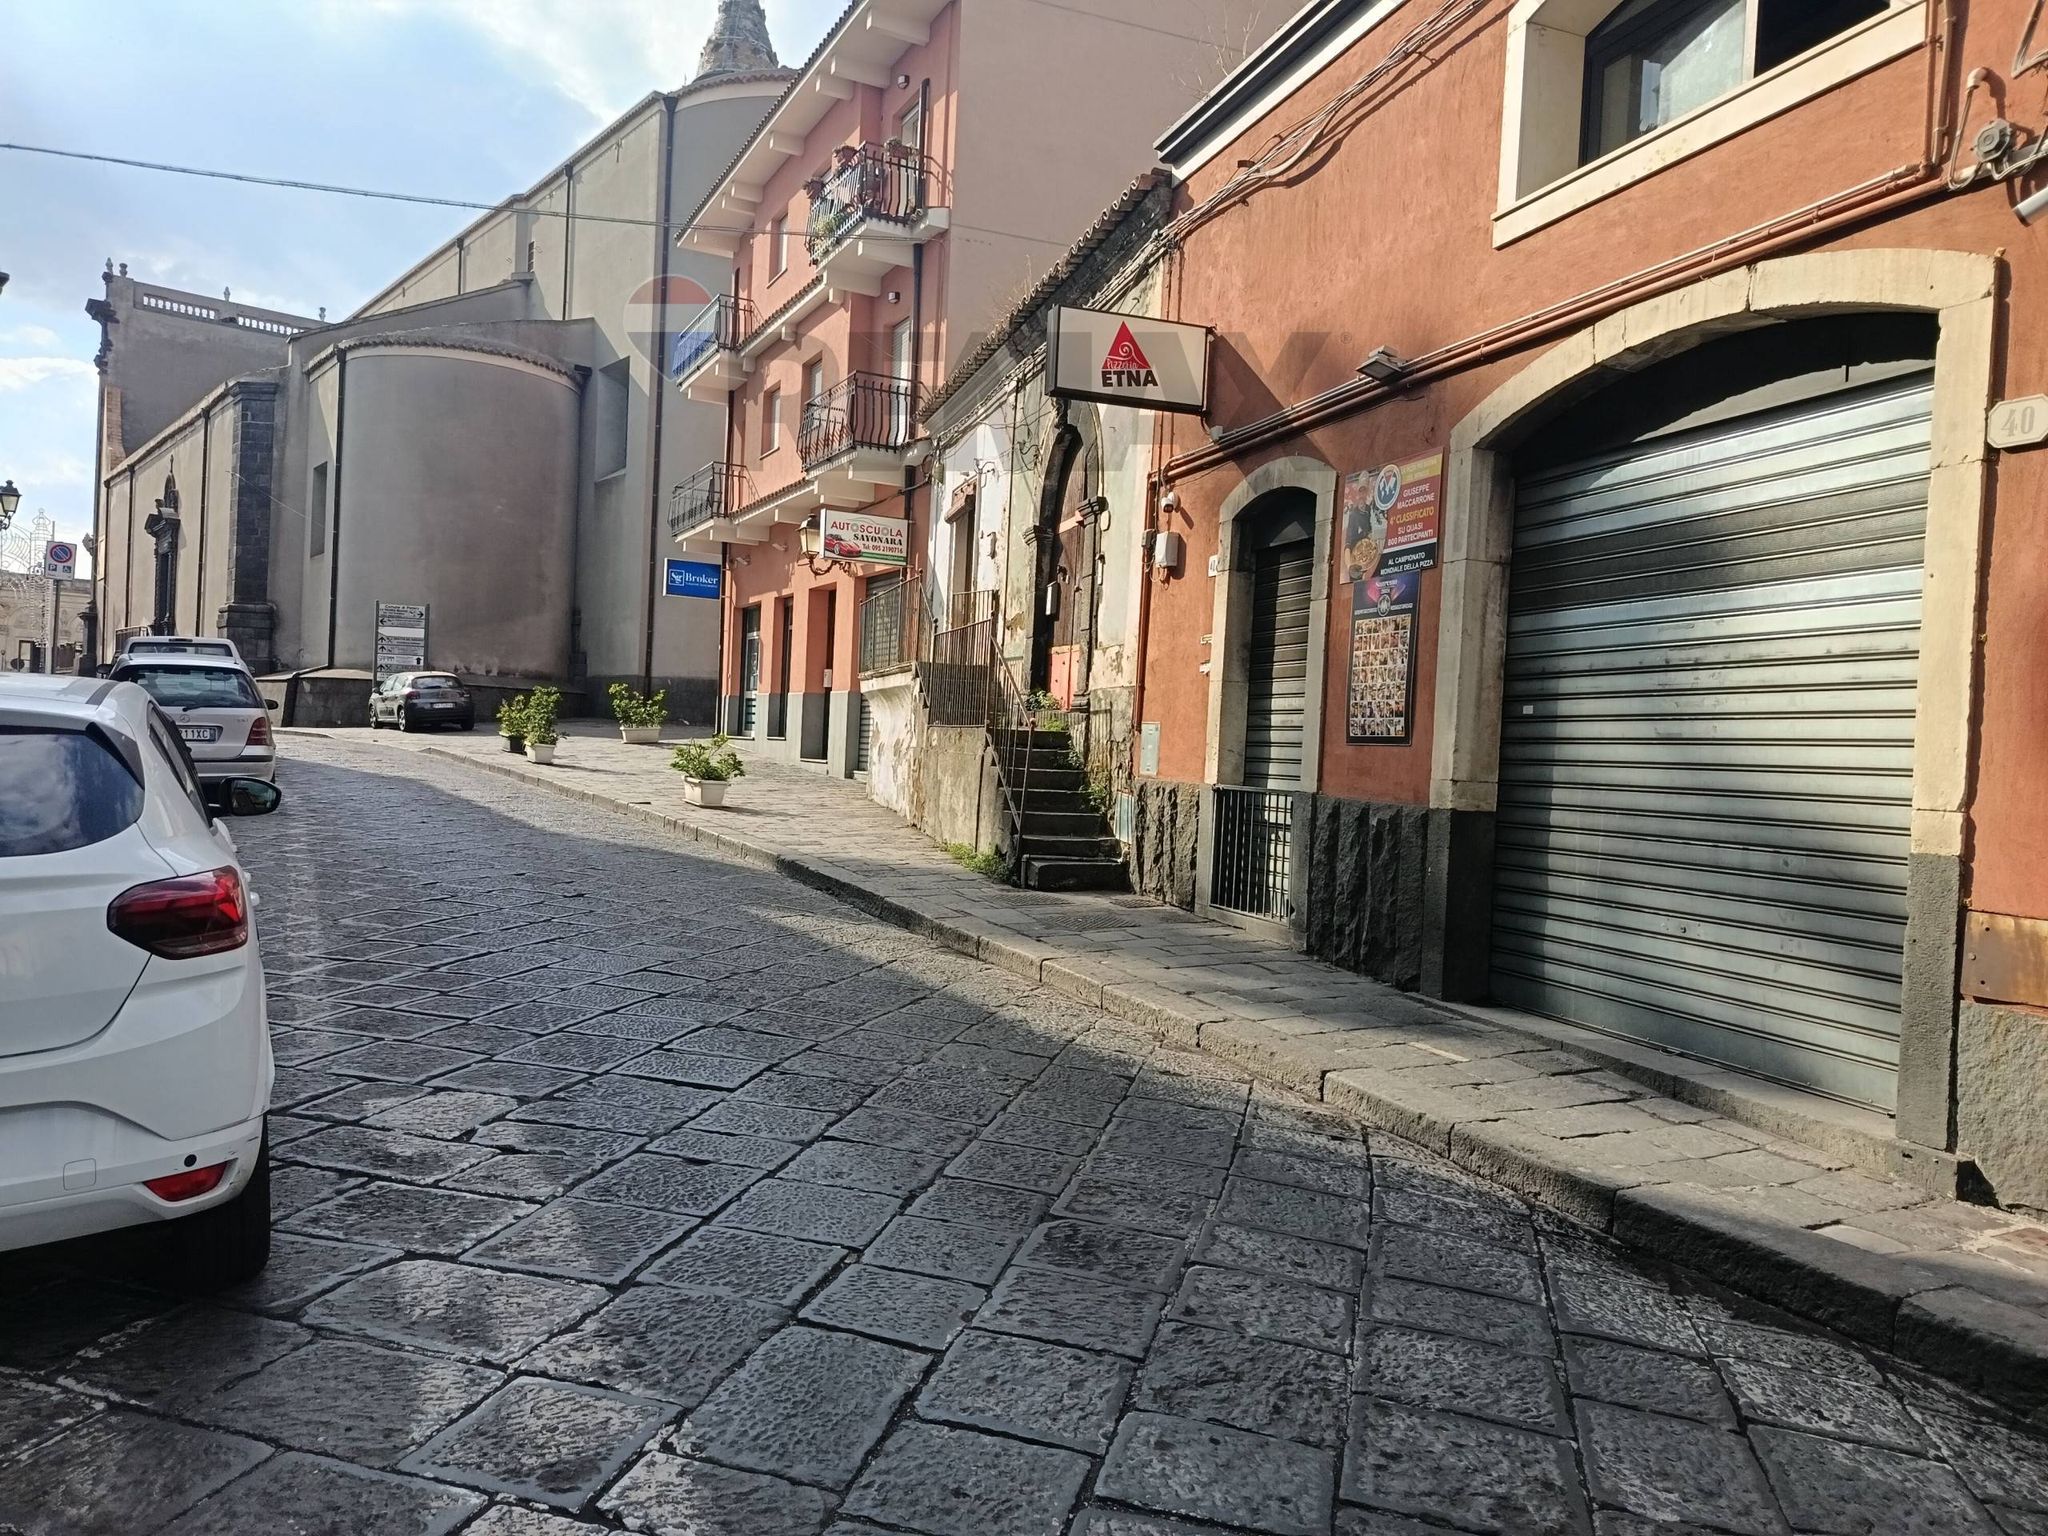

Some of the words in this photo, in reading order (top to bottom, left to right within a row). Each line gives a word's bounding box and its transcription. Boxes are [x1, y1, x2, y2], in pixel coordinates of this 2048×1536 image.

[1101, 370, 1158, 387] ETNA
[2000, 406, 2035, 437] 40
[1402, 483, 1430, 498] GIUSEPPE
[1396, 492, 1435, 510] MACCARRONE
[1396, 506, 1435, 524] CLASSIFICATO
[830, 521, 903, 538] AUTOSCUOLA
[1397, 526, 1406, 535] SU
[1406, 522, 1424, 533] QUASI
[853, 533, 903, 546] SAYONARA
[1398, 529, 1434, 545] PARTECIPANTI
[871, 544, 881, 552] 095
[1388, 557, 1394, 565] AL
[1394, 551, 1426, 564] CAMPIONATO
[1380, 564, 1404, 576] MONDIALE
[1403, 561, 1420, 571] DELLA
[1419, 559, 1434, 568] PIZZA
[685, 572, 719, 584] Broker
